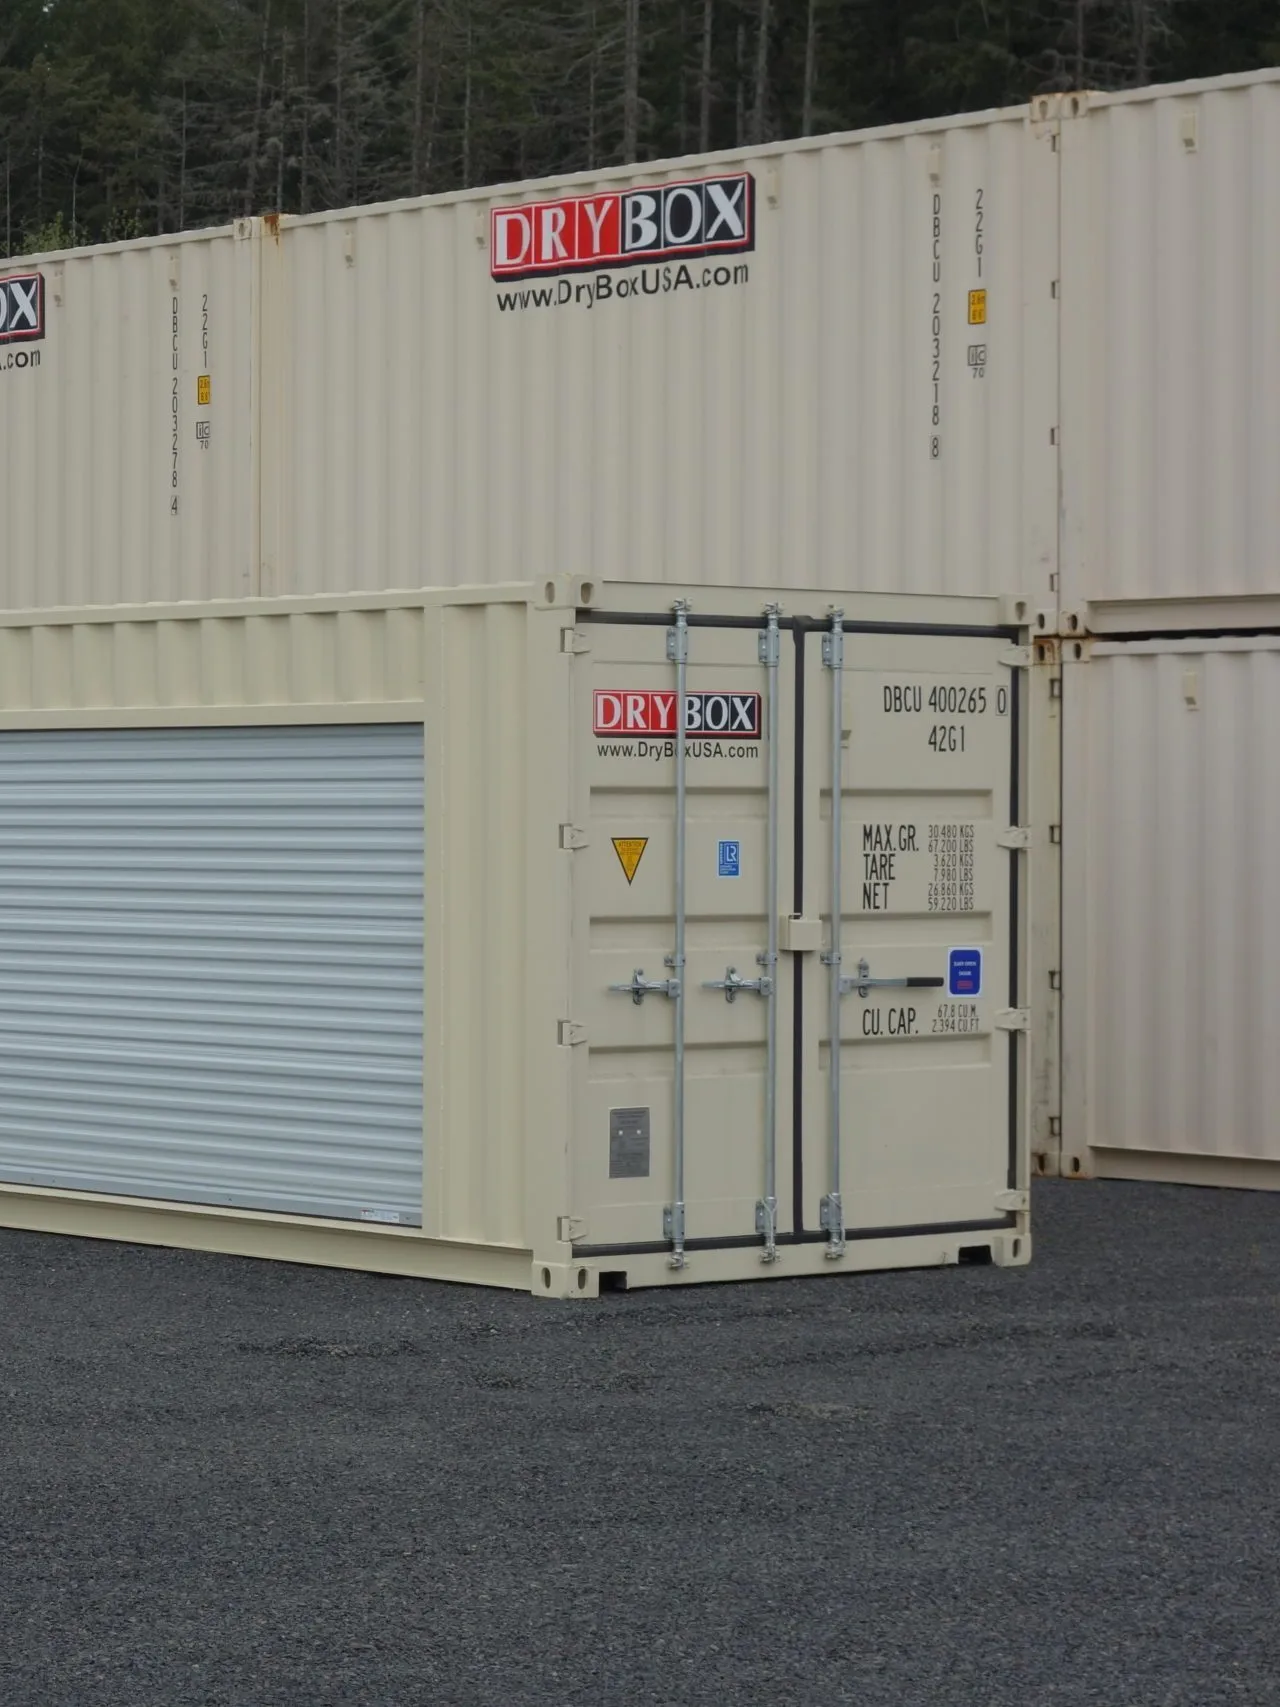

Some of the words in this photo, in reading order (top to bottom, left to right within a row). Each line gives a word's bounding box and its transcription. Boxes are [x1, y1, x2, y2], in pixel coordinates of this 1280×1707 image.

[932, 193, 940, 282] DBCU
[975, 188, 983, 277] 22G1
[496, 264, 749, 312] www.DryBoxUSA.com
[932, 293, 940, 426] 203218
[931, 436, 939, 458] 8
[883, 685, 922, 713] DBCU
[928, 685, 987, 713] 400265
[997, 687, 1007, 714] 0
[597, 741, 759, 761] www.DryBxUSA.com
[928, 724, 965, 752] 42G1
[959, 824, 974, 838] KGS
[959, 839, 974, 853] LBS
[863, 853, 896, 881] TARE
[959, 868, 974, 881] LBS
[863, 882, 890, 910] NET
[959, 896, 974, 911] LBS
